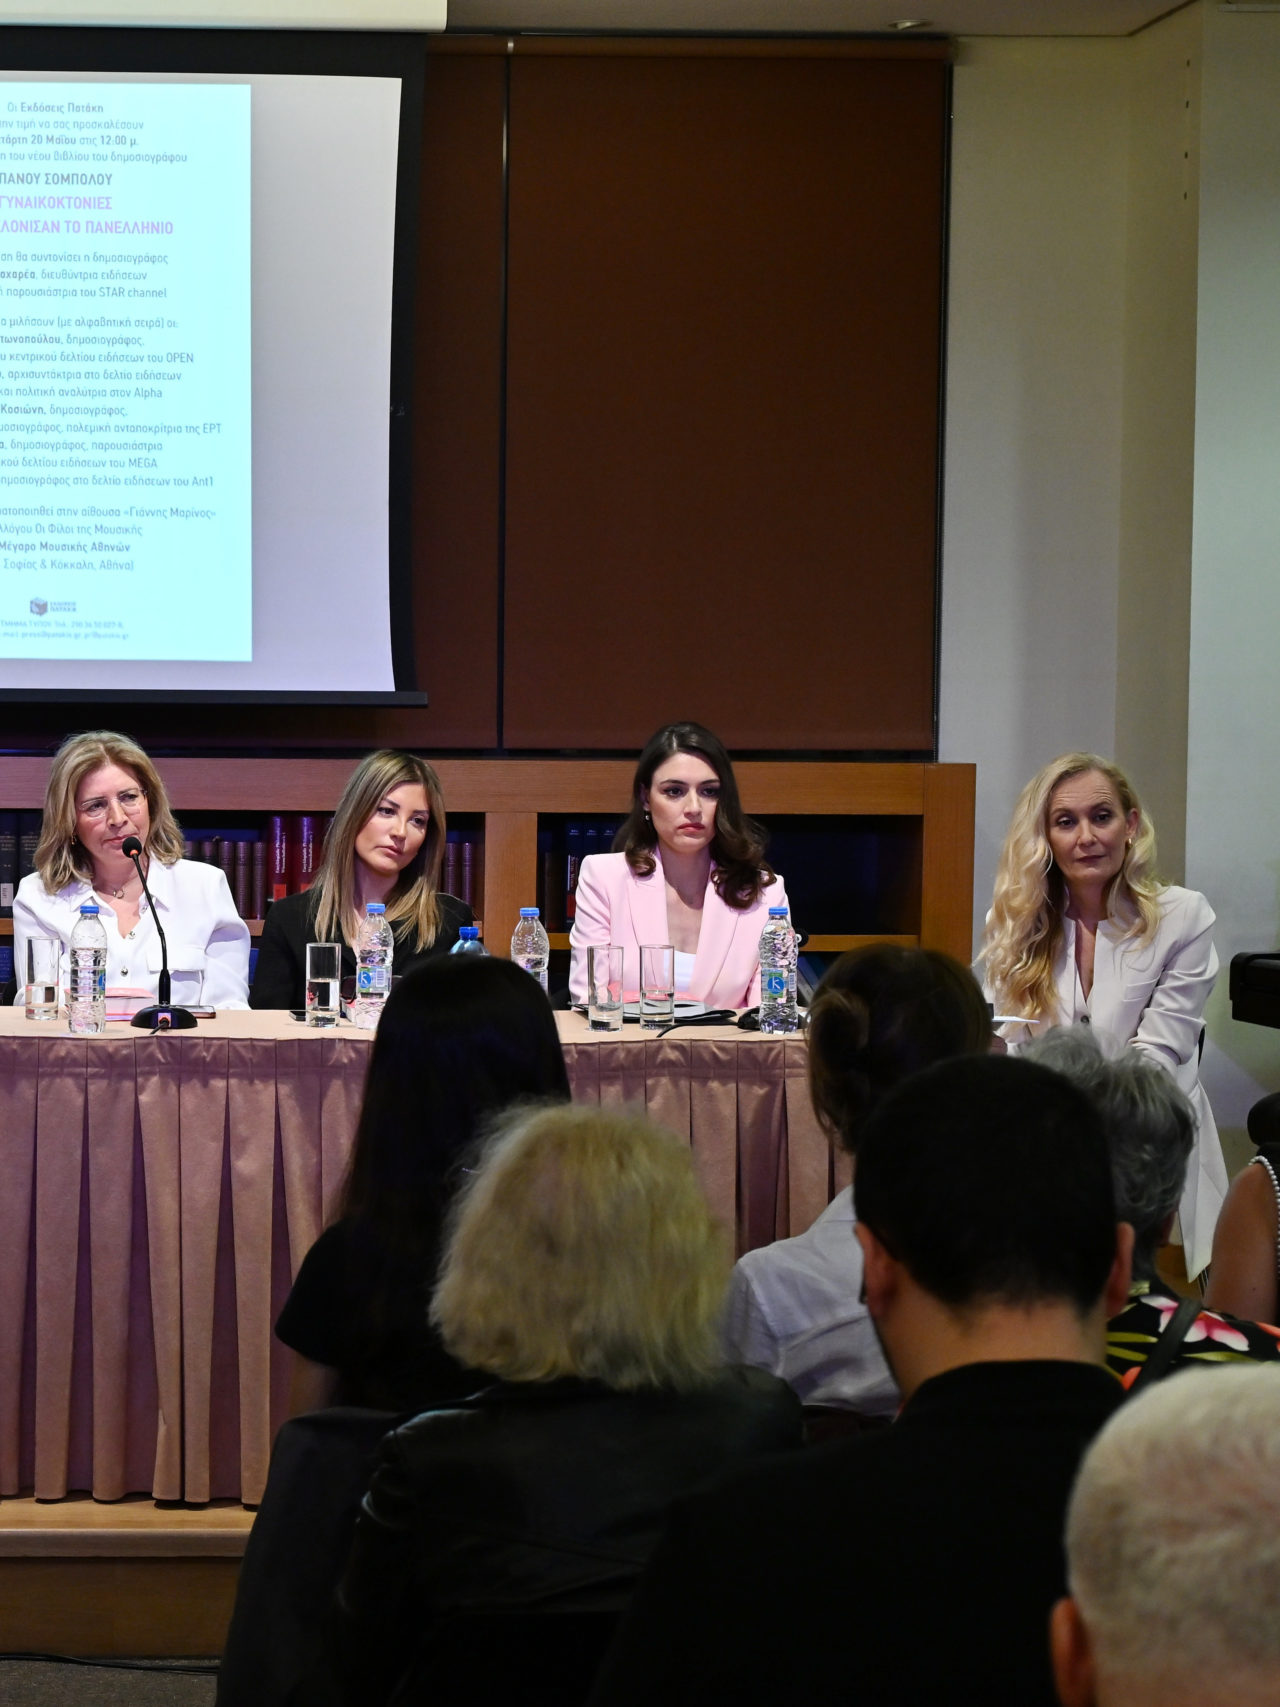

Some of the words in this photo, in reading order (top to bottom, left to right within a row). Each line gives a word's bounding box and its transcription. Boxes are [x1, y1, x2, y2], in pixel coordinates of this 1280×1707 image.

[44, 172, 112, 185] ΣΟΜΠΟΛΟΥ
[85, 220, 173, 234] ΠΑΝΕΛΛΗΝΙΟ
[98, 286, 125, 297] STAR
[166, 352, 194, 363] OPEN
[128, 457, 158, 468] MEGA
